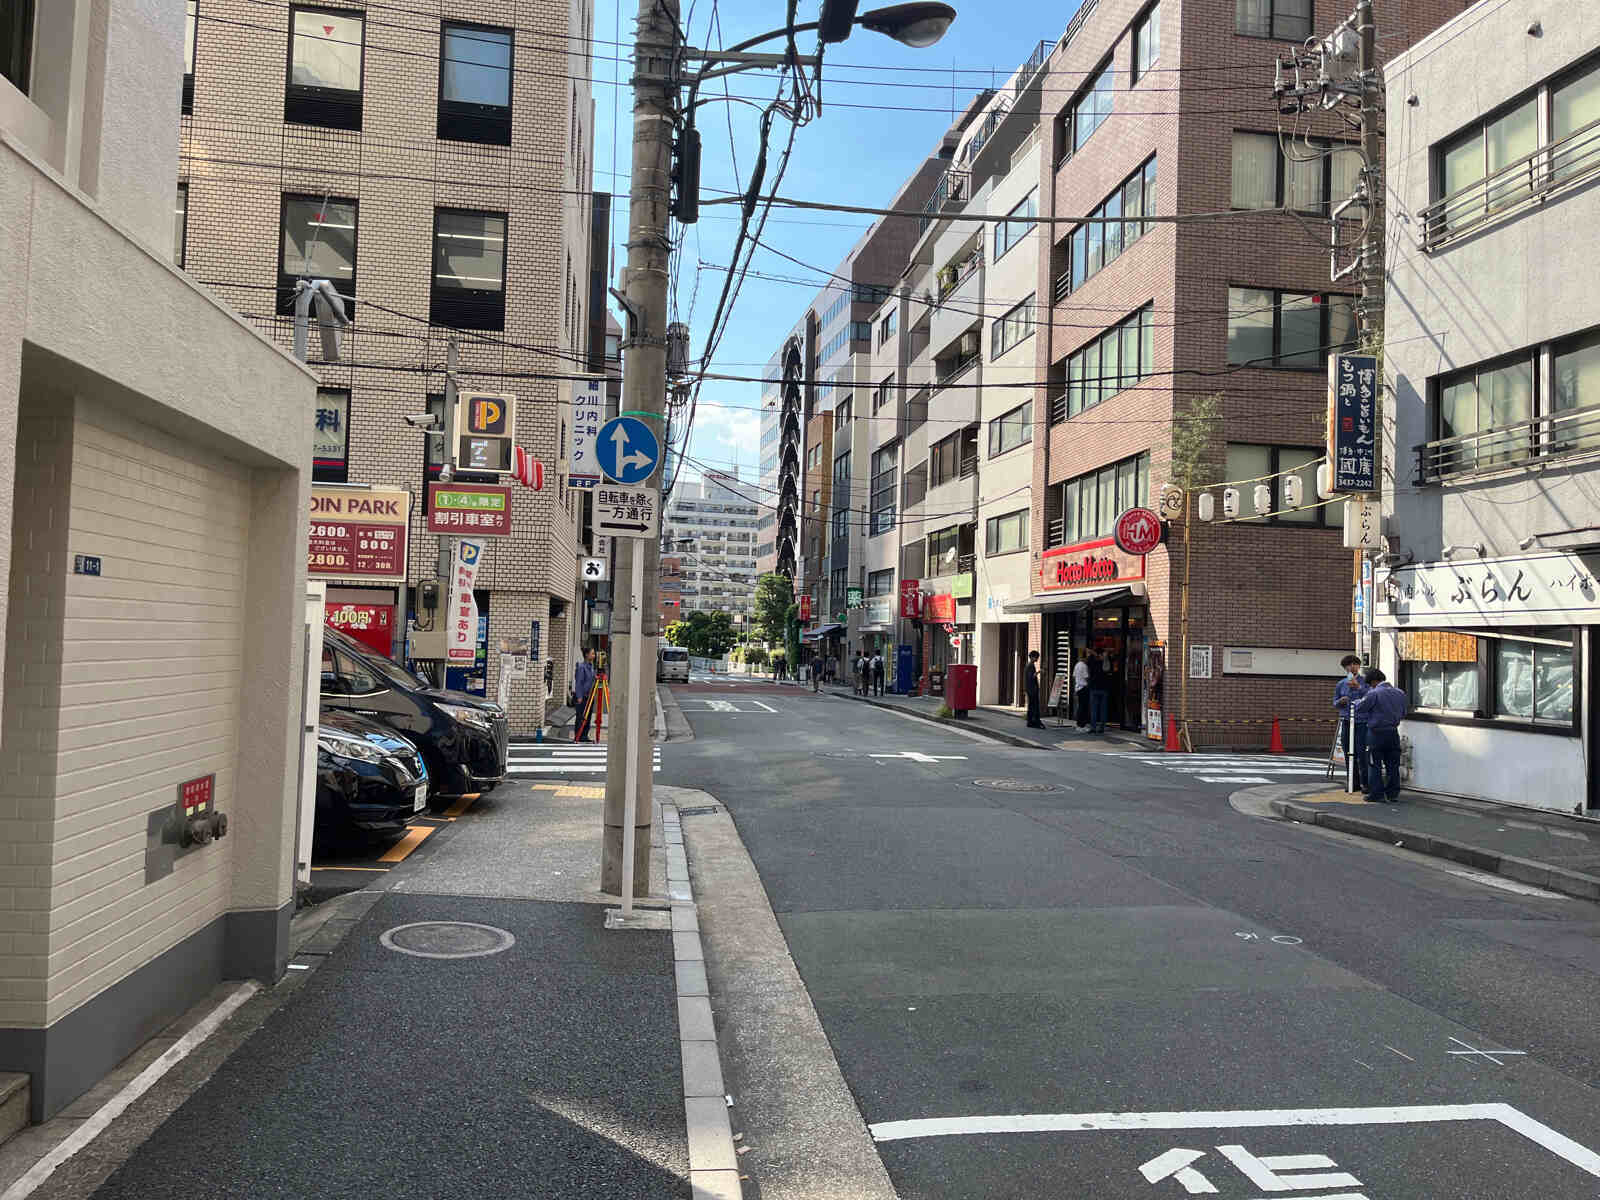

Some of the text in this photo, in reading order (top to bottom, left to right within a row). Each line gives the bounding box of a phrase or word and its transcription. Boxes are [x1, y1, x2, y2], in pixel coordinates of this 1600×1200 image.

[315, 408, 339, 433] 科
[573, 395, 586, 462] クリニック
[347, 498, 400, 515] PARK
[599, 491, 653, 507] 自転車を除く
[598, 507, 653, 521] 一方通行
[1361, 505, 1372, 545] ぶらん
[585, 561, 601, 576] お
[1451, 569, 1533, 604] ぶらん
